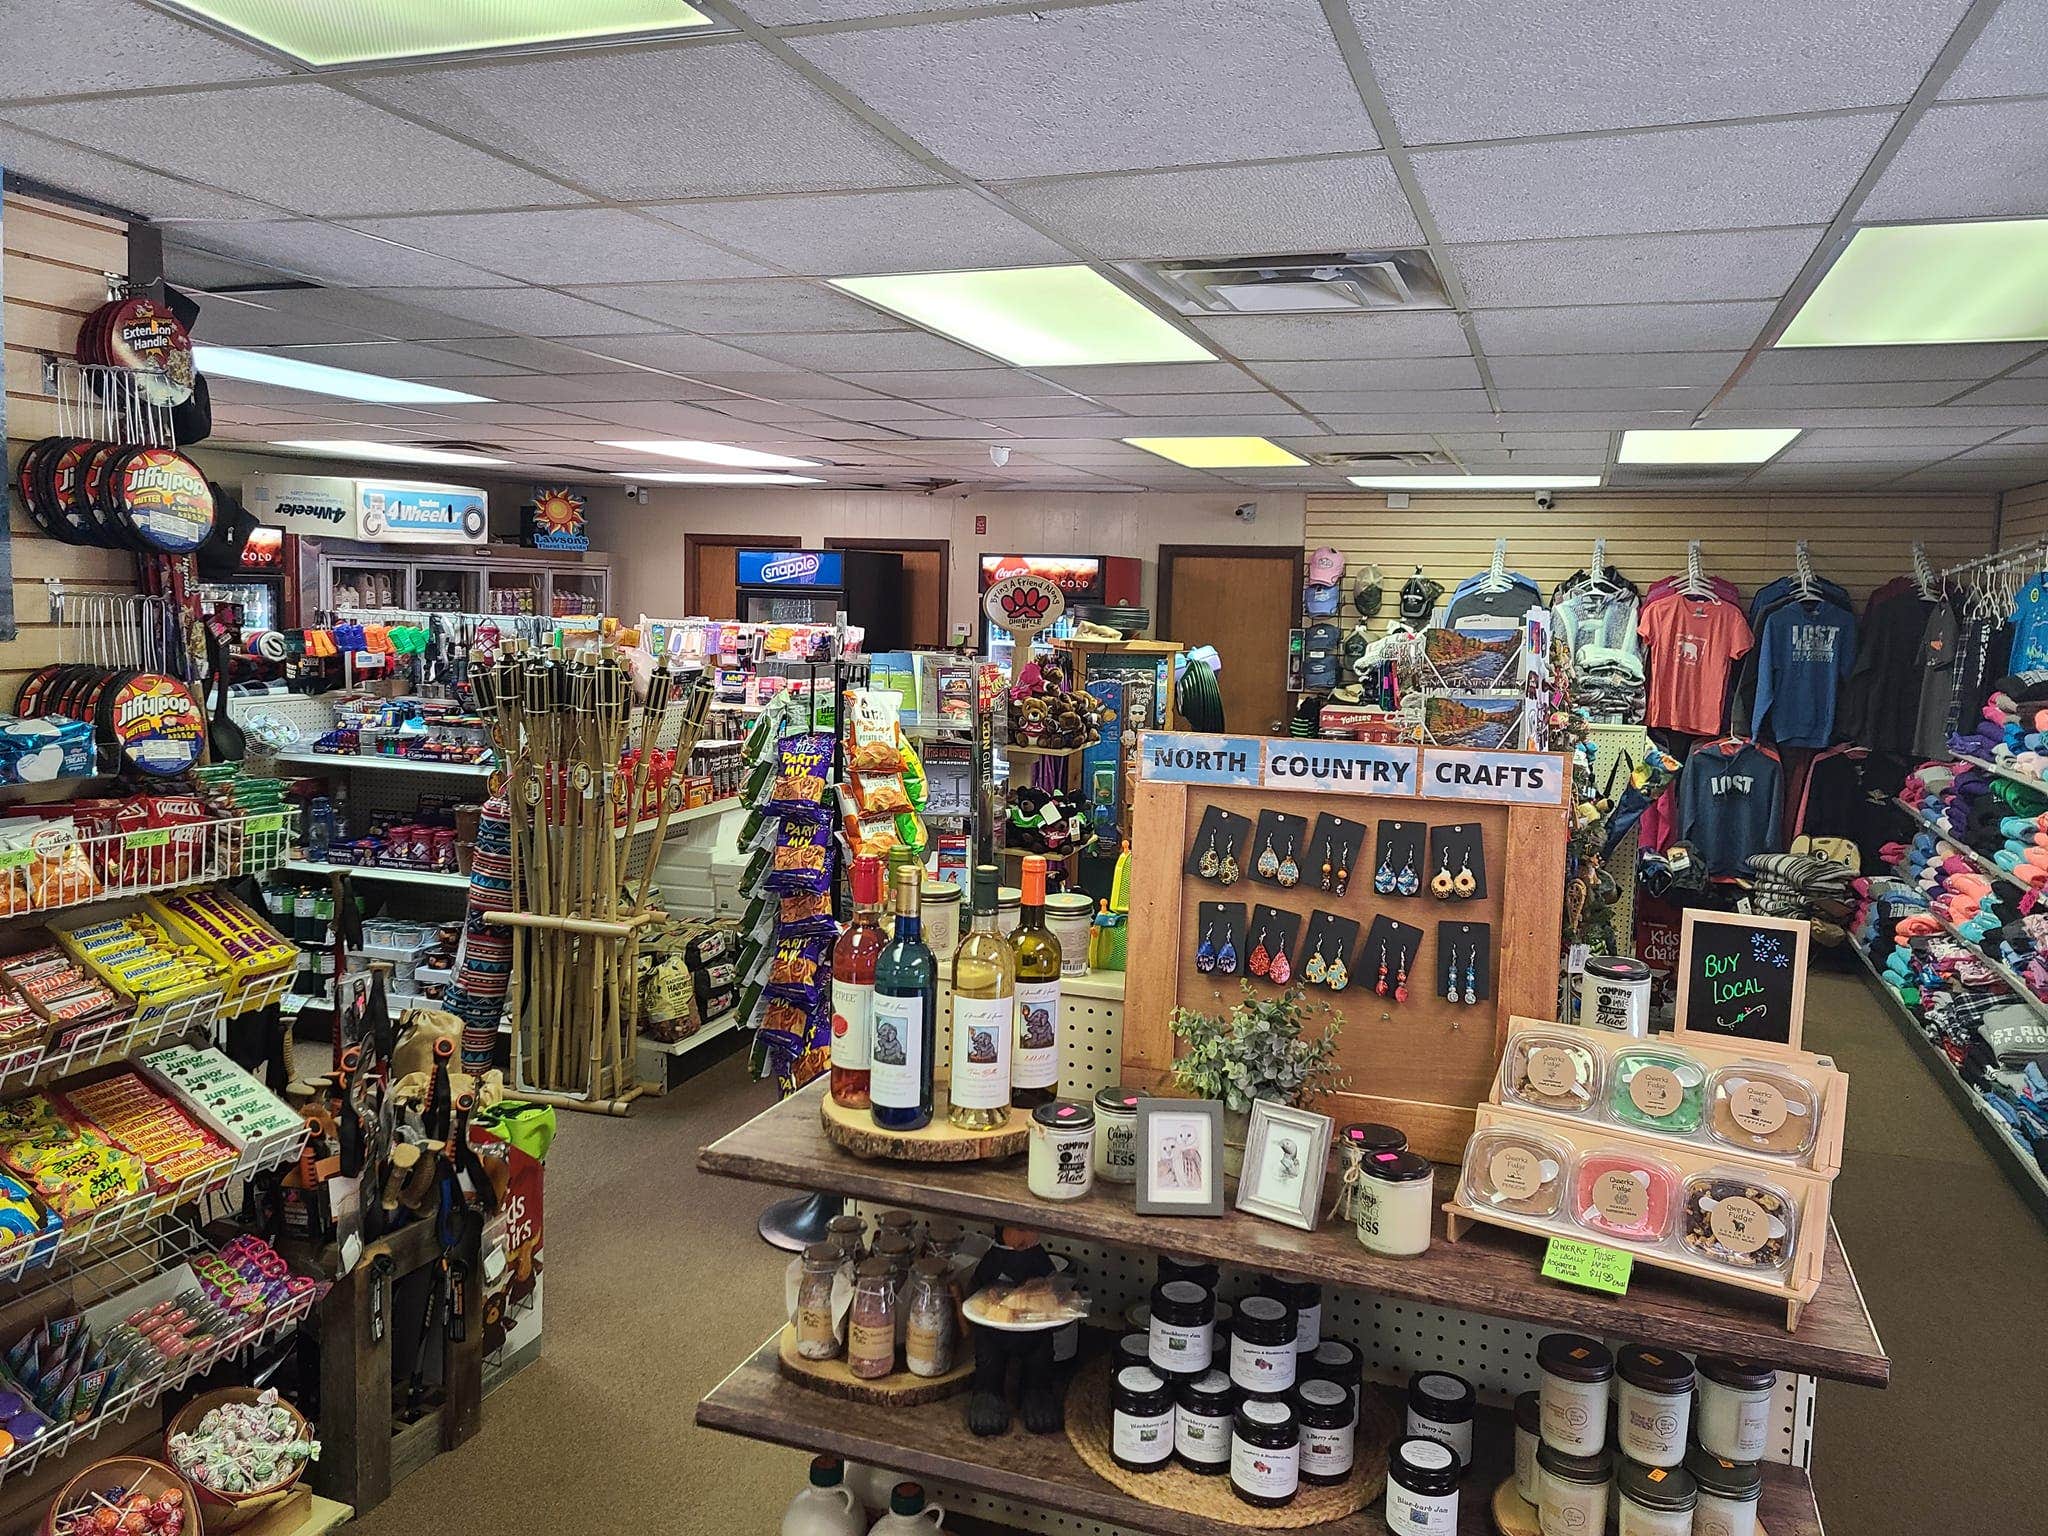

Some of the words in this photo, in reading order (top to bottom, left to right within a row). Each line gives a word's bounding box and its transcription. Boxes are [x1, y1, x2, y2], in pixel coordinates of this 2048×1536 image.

[123, 326, 171, 340] Extenion
[134, 336, 168, 350] Handle
[126, 466, 172, 492] Jiffy
[172, 474, 204, 495] pop
[534, 533, 589, 545] Lawson's
[241, 552, 272, 562] COLD
[765, 556, 816, 578] snapple
[182, 557, 190, 598] Handle
[1060, 579, 1089, 588] COLD
[990, 583, 1009, 604] Bring
[1010, 580, 1016, 588] A
[1016, 577, 1043, 589] Friend
[1045, 584, 1061, 605] Along
[1792, 624, 1840, 645] LOST
[118, 693, 158, 727] Jiffy
[158, 696, 191, 715] pop
[1340, 715, 1372, 725] Yahtzee
[125, 722, 151, 739] BUTTER
[795, 744, 815, 753] utz
[782, 752, 822, 766] PARTY
[784, 765, 811, 778] MIX
[1153, 747, 1247, 772] NORTH
[1271, 755, 1410, 783] COUNTRY
[1435, 762, 1544, 789] CRAFTS
[1711, 775, 1754, 796] LOST
[785, 822, 819, 836] PARTY
[787, 836, 812, 848] MIX
[73, 919, 123, 940] Butterfinger
[1651, 930, 1680, 946] Kids
[83, 931, 135, 950] Butterfinger
[778, 949, 801, 963] MIX
[1644, 944, 1680, 960] Chair
[123, 959, 175, 980] Butterfinger
[1705, 953, 1741, 978] BUY
[1714, 978, 1765, 1004] LOCAL
[1596, 1013, 1627, 1030] Place
[145, 1049, 178, 1064] unior
[166, 1053, 204, 1071] Junior
[192, 1057, 218, 1069] Mints
[185, 1068, 223, 1086] Junior
[211, 1072, 237, 1084] Mints
[203, 1083, 242, 1101] Junior
[230, 1087, 256, 1099] Mints
[221, 1098, 259, 1118] Junior
[247, 1102, 273, 1114] Mints
[116, 1114, 159, 1135] Starburst
[240, 1114, 278, 1134] Junior
[266, 1118, 291, 1130] Mints
[1107, 1125, 1133, 1142] Camp
[144, 1134, 188, 1155] Starburst
[161, 1151, 204, 1171] Starburst
[171, 1155, 214, 1177] Starburst
[1106, 1151, 1135, 1166] LESS
[90, 1171, 122, 1196] SOUR
[1611, 1184, 1632, 1193] Fudge
[1727, 1204, 1756, 1216] Qwerkz
[1728, 1211, 1753, 1223] Fudge
[1552, 1240, 1588, 1255] QWERKZ
[1593, 1247, 1617, 1261] FUDGE
[1560, 1253, 1585, 1264] LOCALLY
[1438, 1428, 1452, 1436] Jam
[1434, 1505, 1448, 1513] Jam
